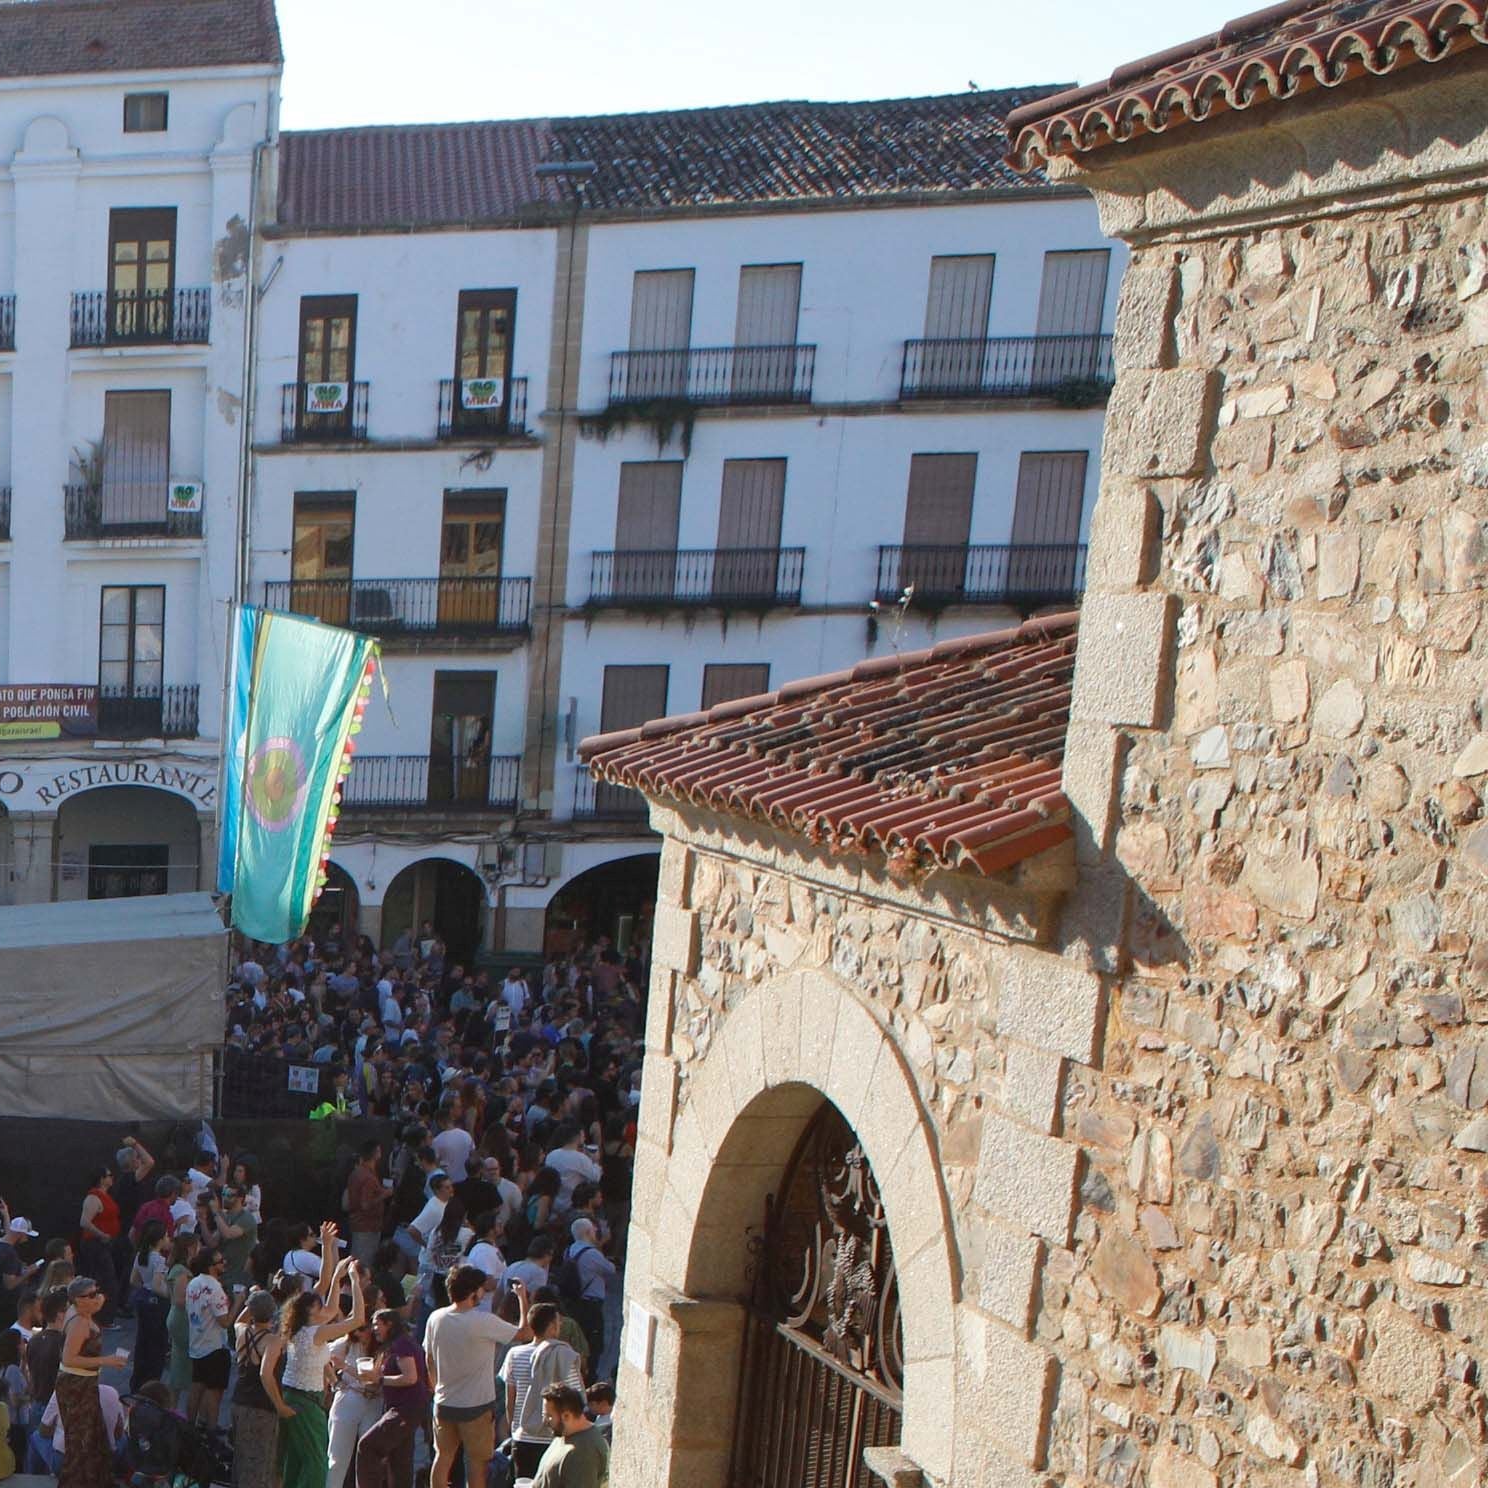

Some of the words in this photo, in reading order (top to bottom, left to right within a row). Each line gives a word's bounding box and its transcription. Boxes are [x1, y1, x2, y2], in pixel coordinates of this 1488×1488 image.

[317, 384, 338, 395] NO
[310, 399, 343, 409] MINA
[465, 395, 498, 405] MINA
[176, 485, 193, 496] NO
[170, 499, 196, 508] MINA
[17, 688, 38, 701] QUE
[40, 688, 74, 700] PONGA
[77, 687, 95, 700] FIN
[3, 703, 60, 718] POBLACIÓN
[63, 704, 89, 717] CIVIL
[36, 763, 217, 806] RESTAURANTE
